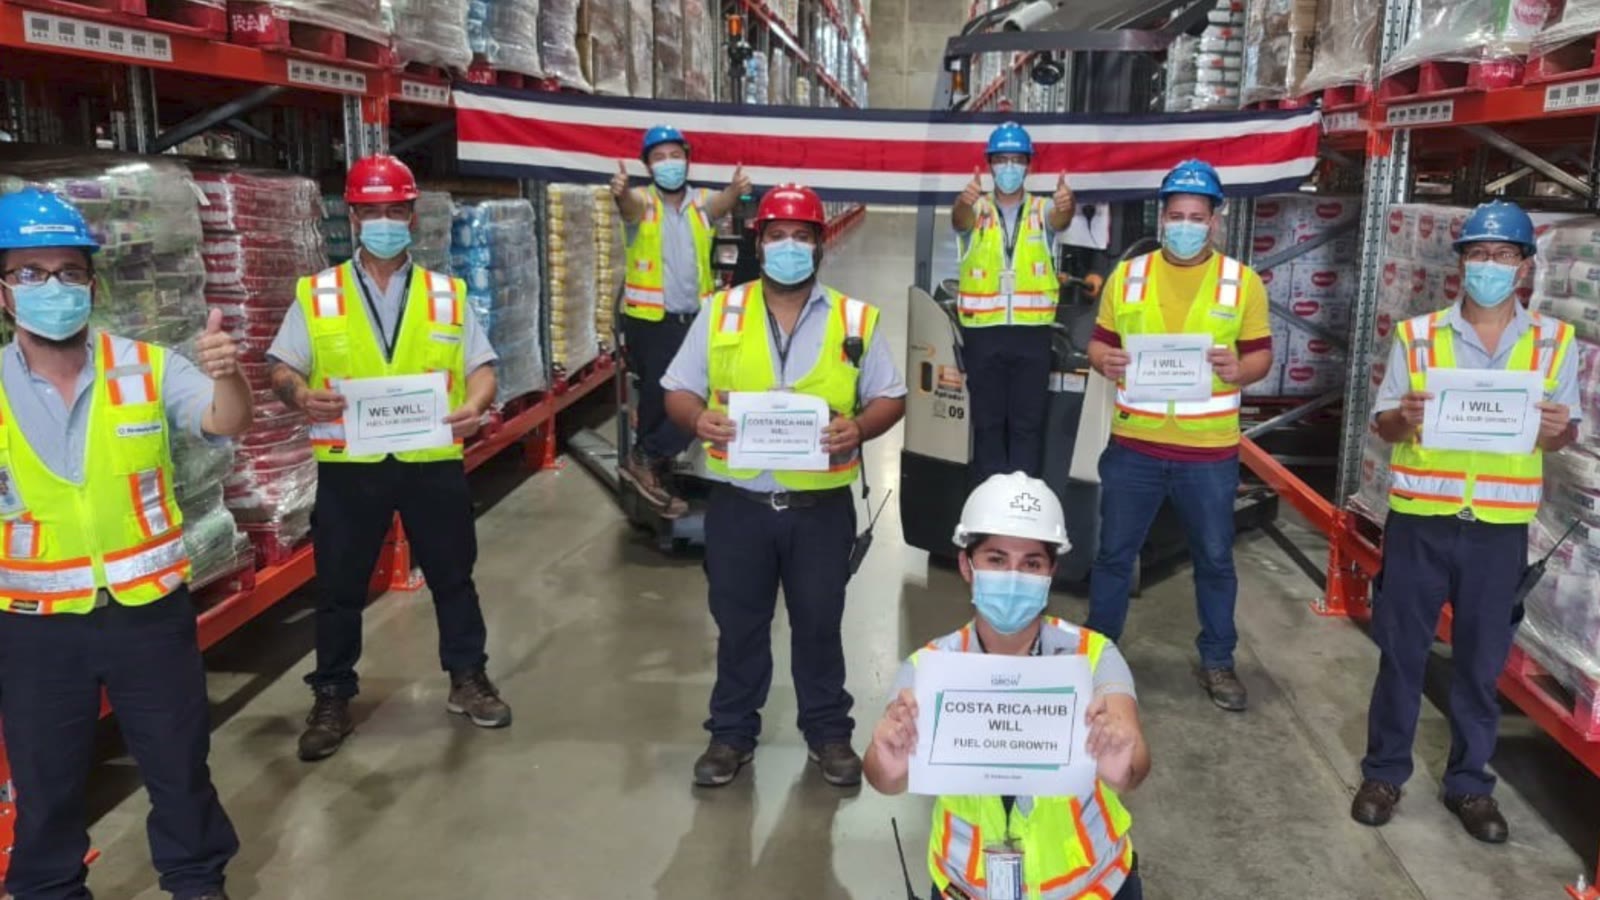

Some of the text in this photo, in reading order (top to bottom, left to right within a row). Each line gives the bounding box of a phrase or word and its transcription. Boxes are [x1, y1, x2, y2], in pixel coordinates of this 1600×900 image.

[1159, 359, 1185, 368] WILL
[368, 403, 426, 417] WE WILL
[949, 405, 965, 419] 09
[1469, 400, 1504, 413] WILL
[945, 701, 1068, 716] COSTA RICA-HUB
[988, 719, 1023, 732] WILL
[953, 737, 1058, 751] FUEL OUR GROWTH
